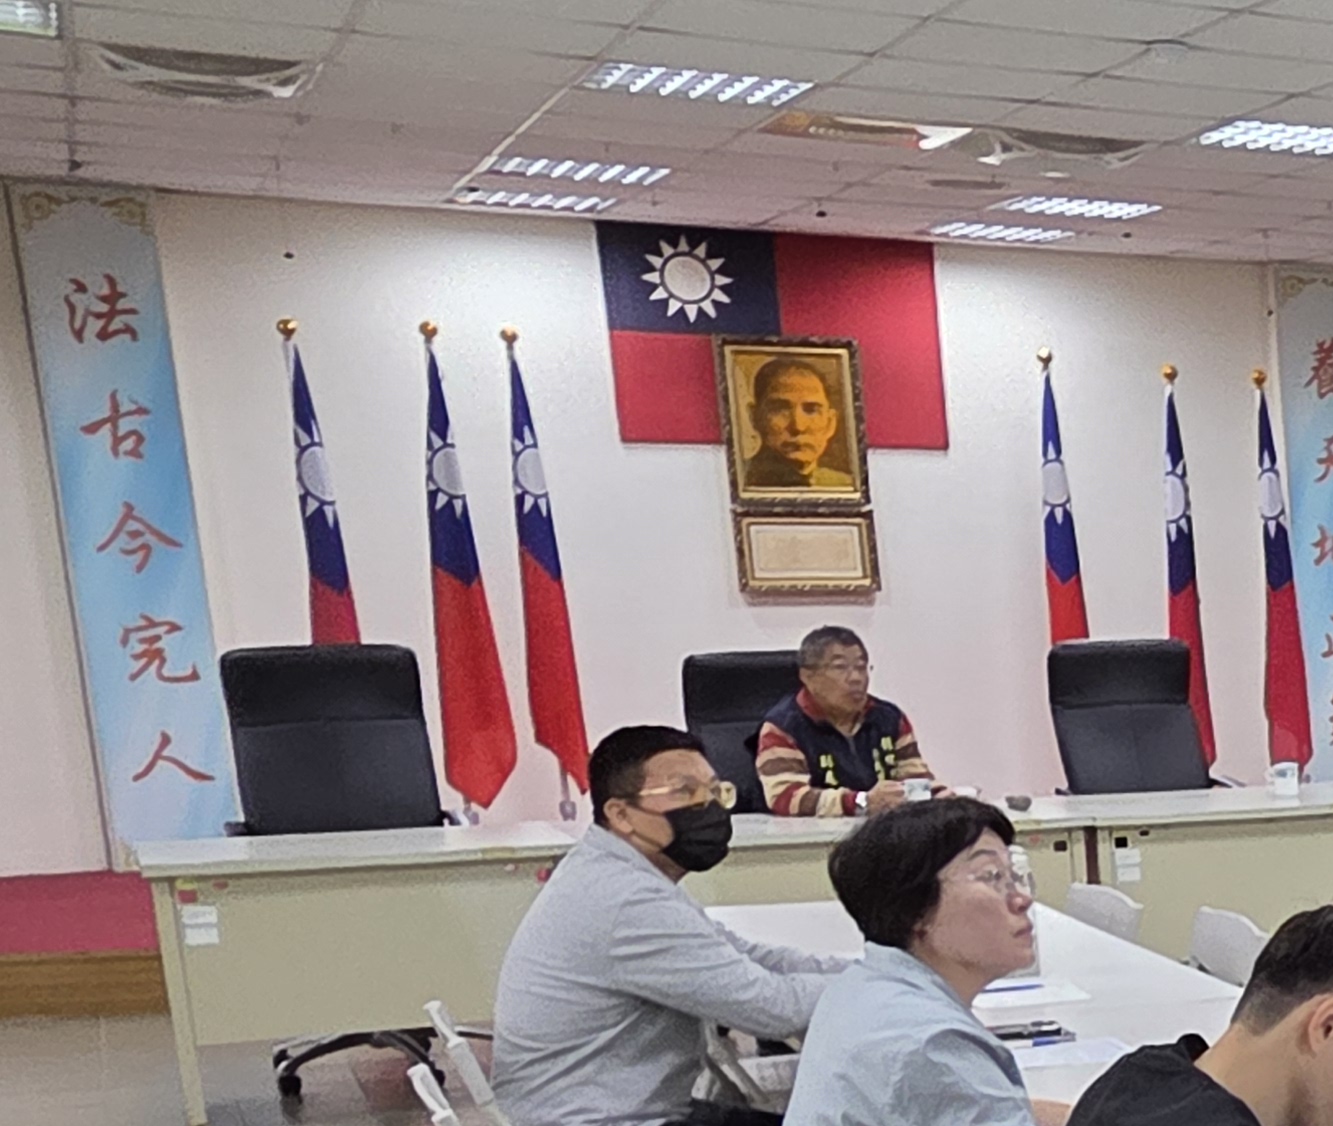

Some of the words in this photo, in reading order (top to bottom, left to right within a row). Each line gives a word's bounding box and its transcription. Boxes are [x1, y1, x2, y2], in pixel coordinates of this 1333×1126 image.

[63, 273, 215, 783] 法古今完人
